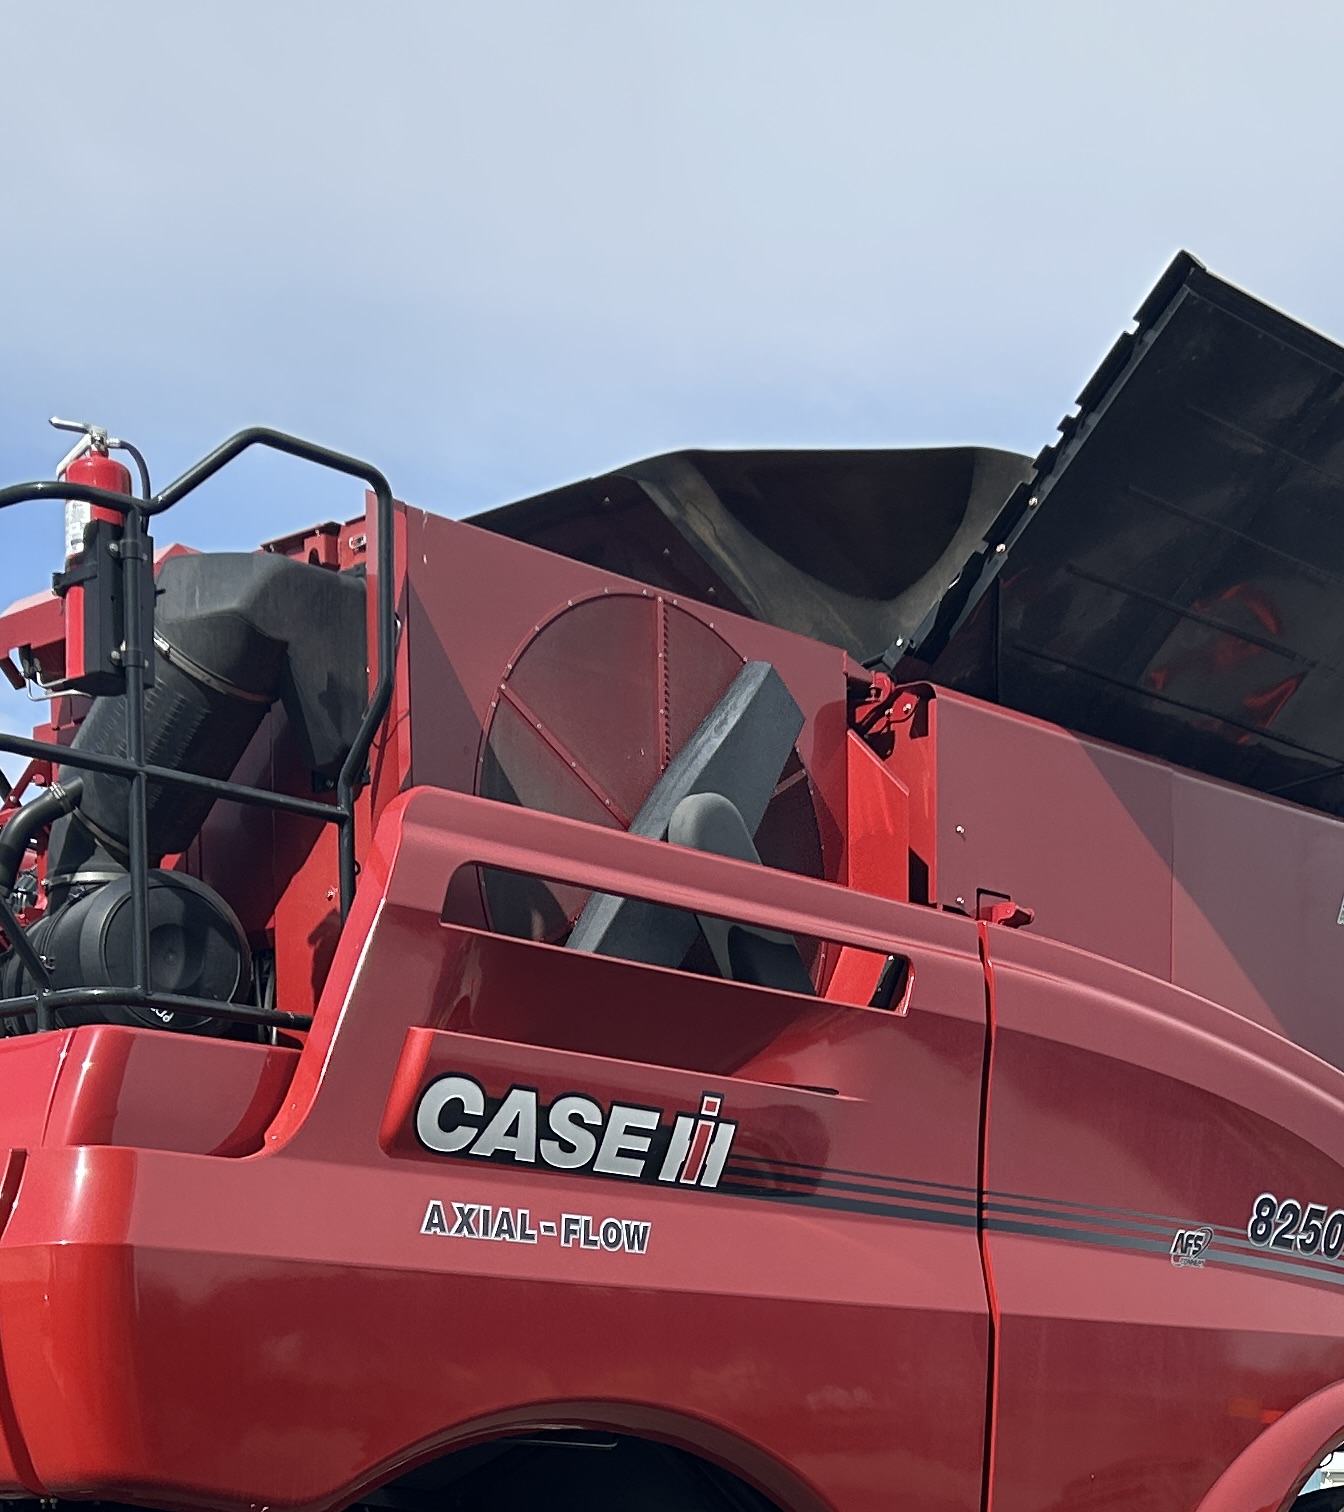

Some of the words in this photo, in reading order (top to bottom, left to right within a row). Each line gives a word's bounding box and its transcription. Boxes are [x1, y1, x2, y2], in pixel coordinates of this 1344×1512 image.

[417, 1076, 660, 1177] CASE
[421, 1200, 651, 1254] AXIAL-FLOW
[1170, 1230, 1206, 1256] AFS
